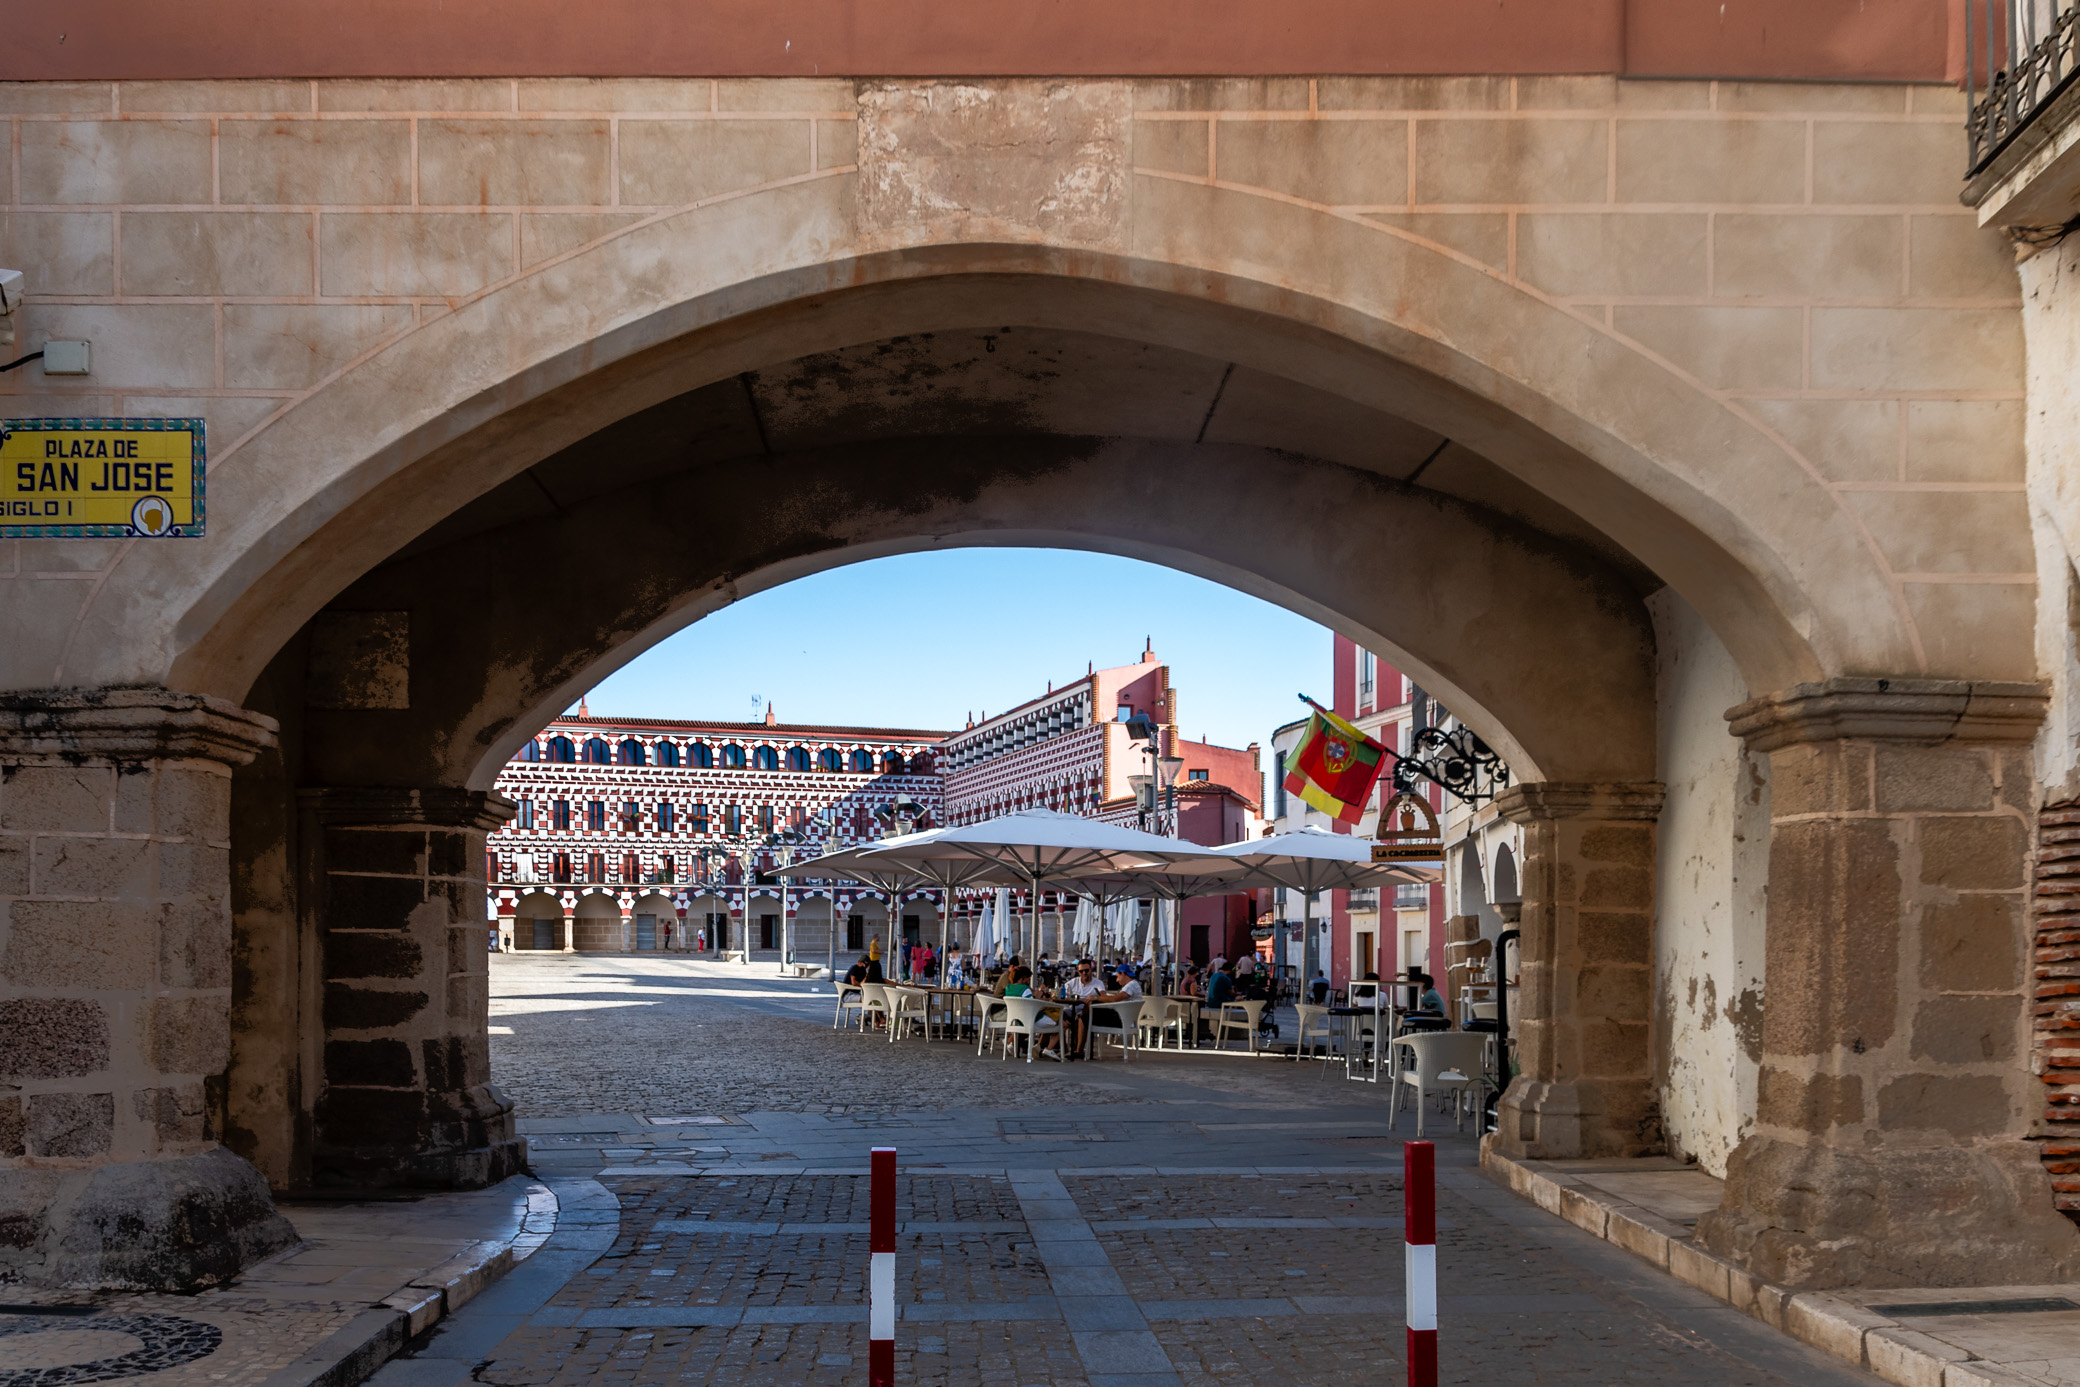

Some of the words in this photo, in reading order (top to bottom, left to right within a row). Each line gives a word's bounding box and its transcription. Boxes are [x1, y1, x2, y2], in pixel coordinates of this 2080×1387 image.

[46, 440, 108, 458] PLAZA
[114, 440, 138, 458] DE
[17, 462, 79, 492] SAN
[91, 462, 173, 492] JOSE
[68, 501, 72, 516] I
